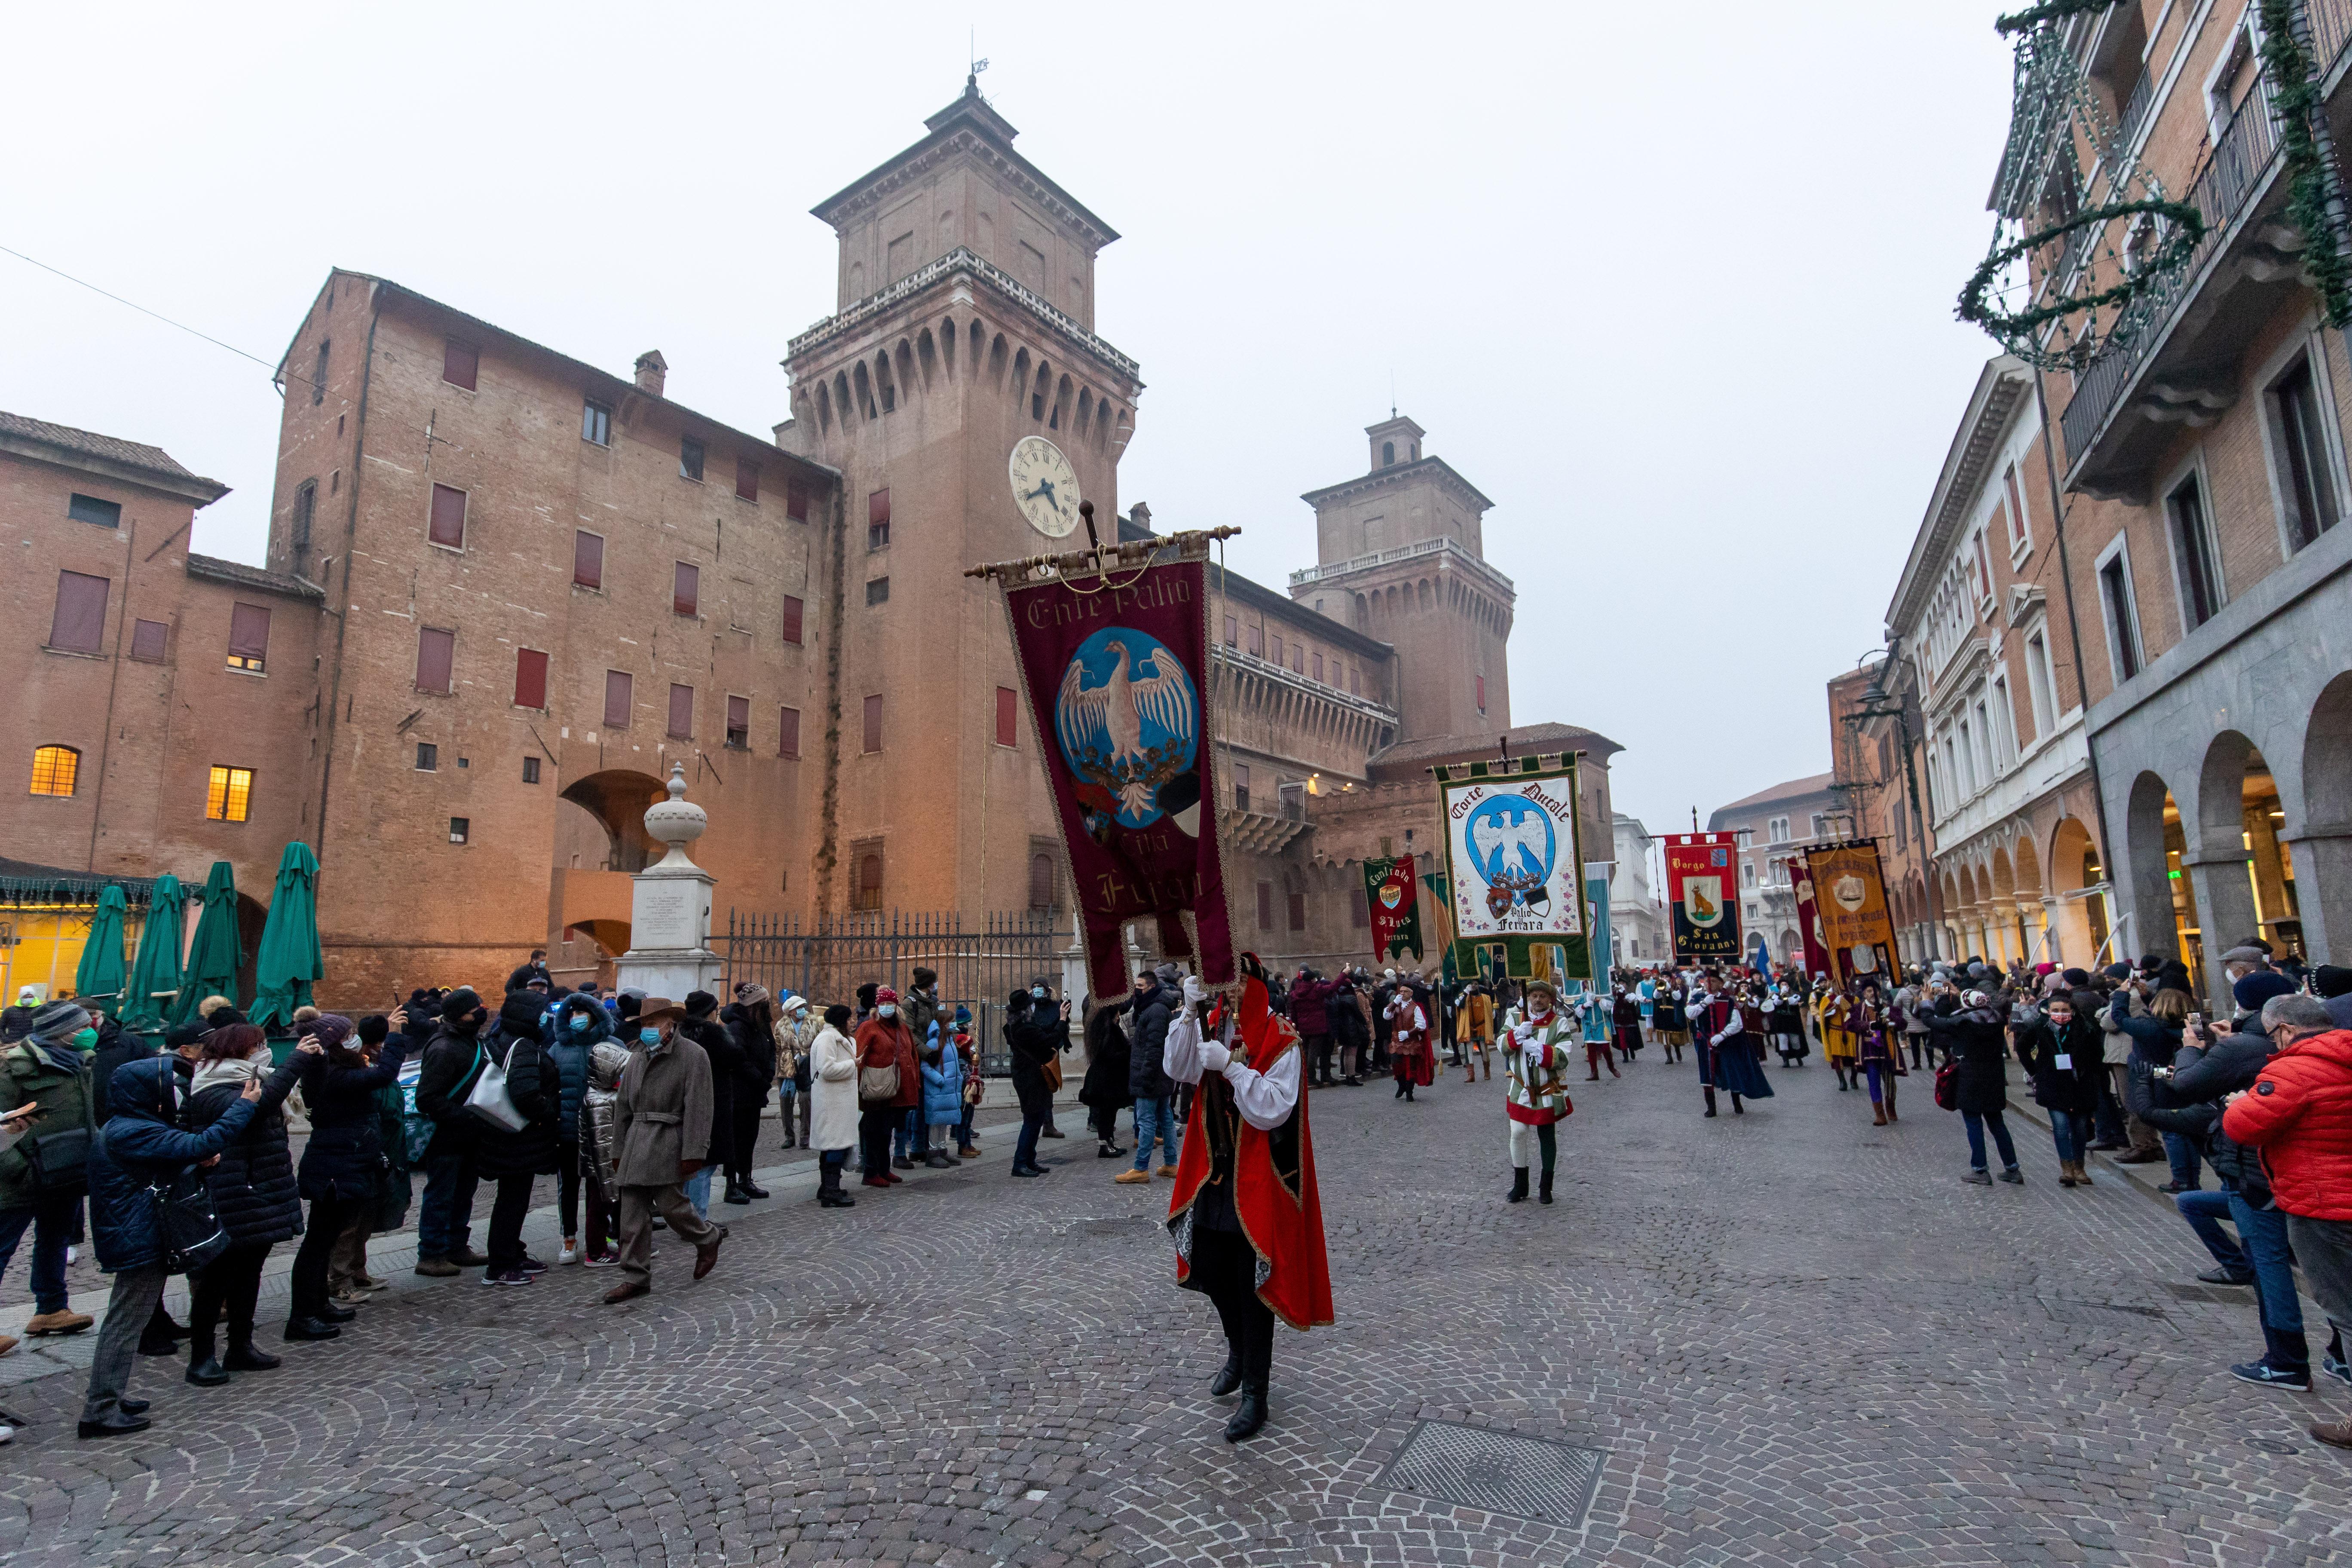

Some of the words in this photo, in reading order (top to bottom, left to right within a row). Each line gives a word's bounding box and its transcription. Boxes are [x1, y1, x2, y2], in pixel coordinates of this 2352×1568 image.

[1028, 590, 1101, 628] Ente
[1114, 574, 1190, 614] Palio
[1450, 786, 1484, 819] Corte
[1521, 782, 1569, 822] Ducale
[1672, 858, 1705, 872] Borgo
[1369, 866, 1409, 885] Contrada
[1511, 906, 1531, 917] Palio
[1387, 916, 1412, 927] Luca
[1497, 919, 1543, 931] Ferrara
[1693, 928, 1719, 940] San
[1678, 935, 1735, 950] Giovanni
